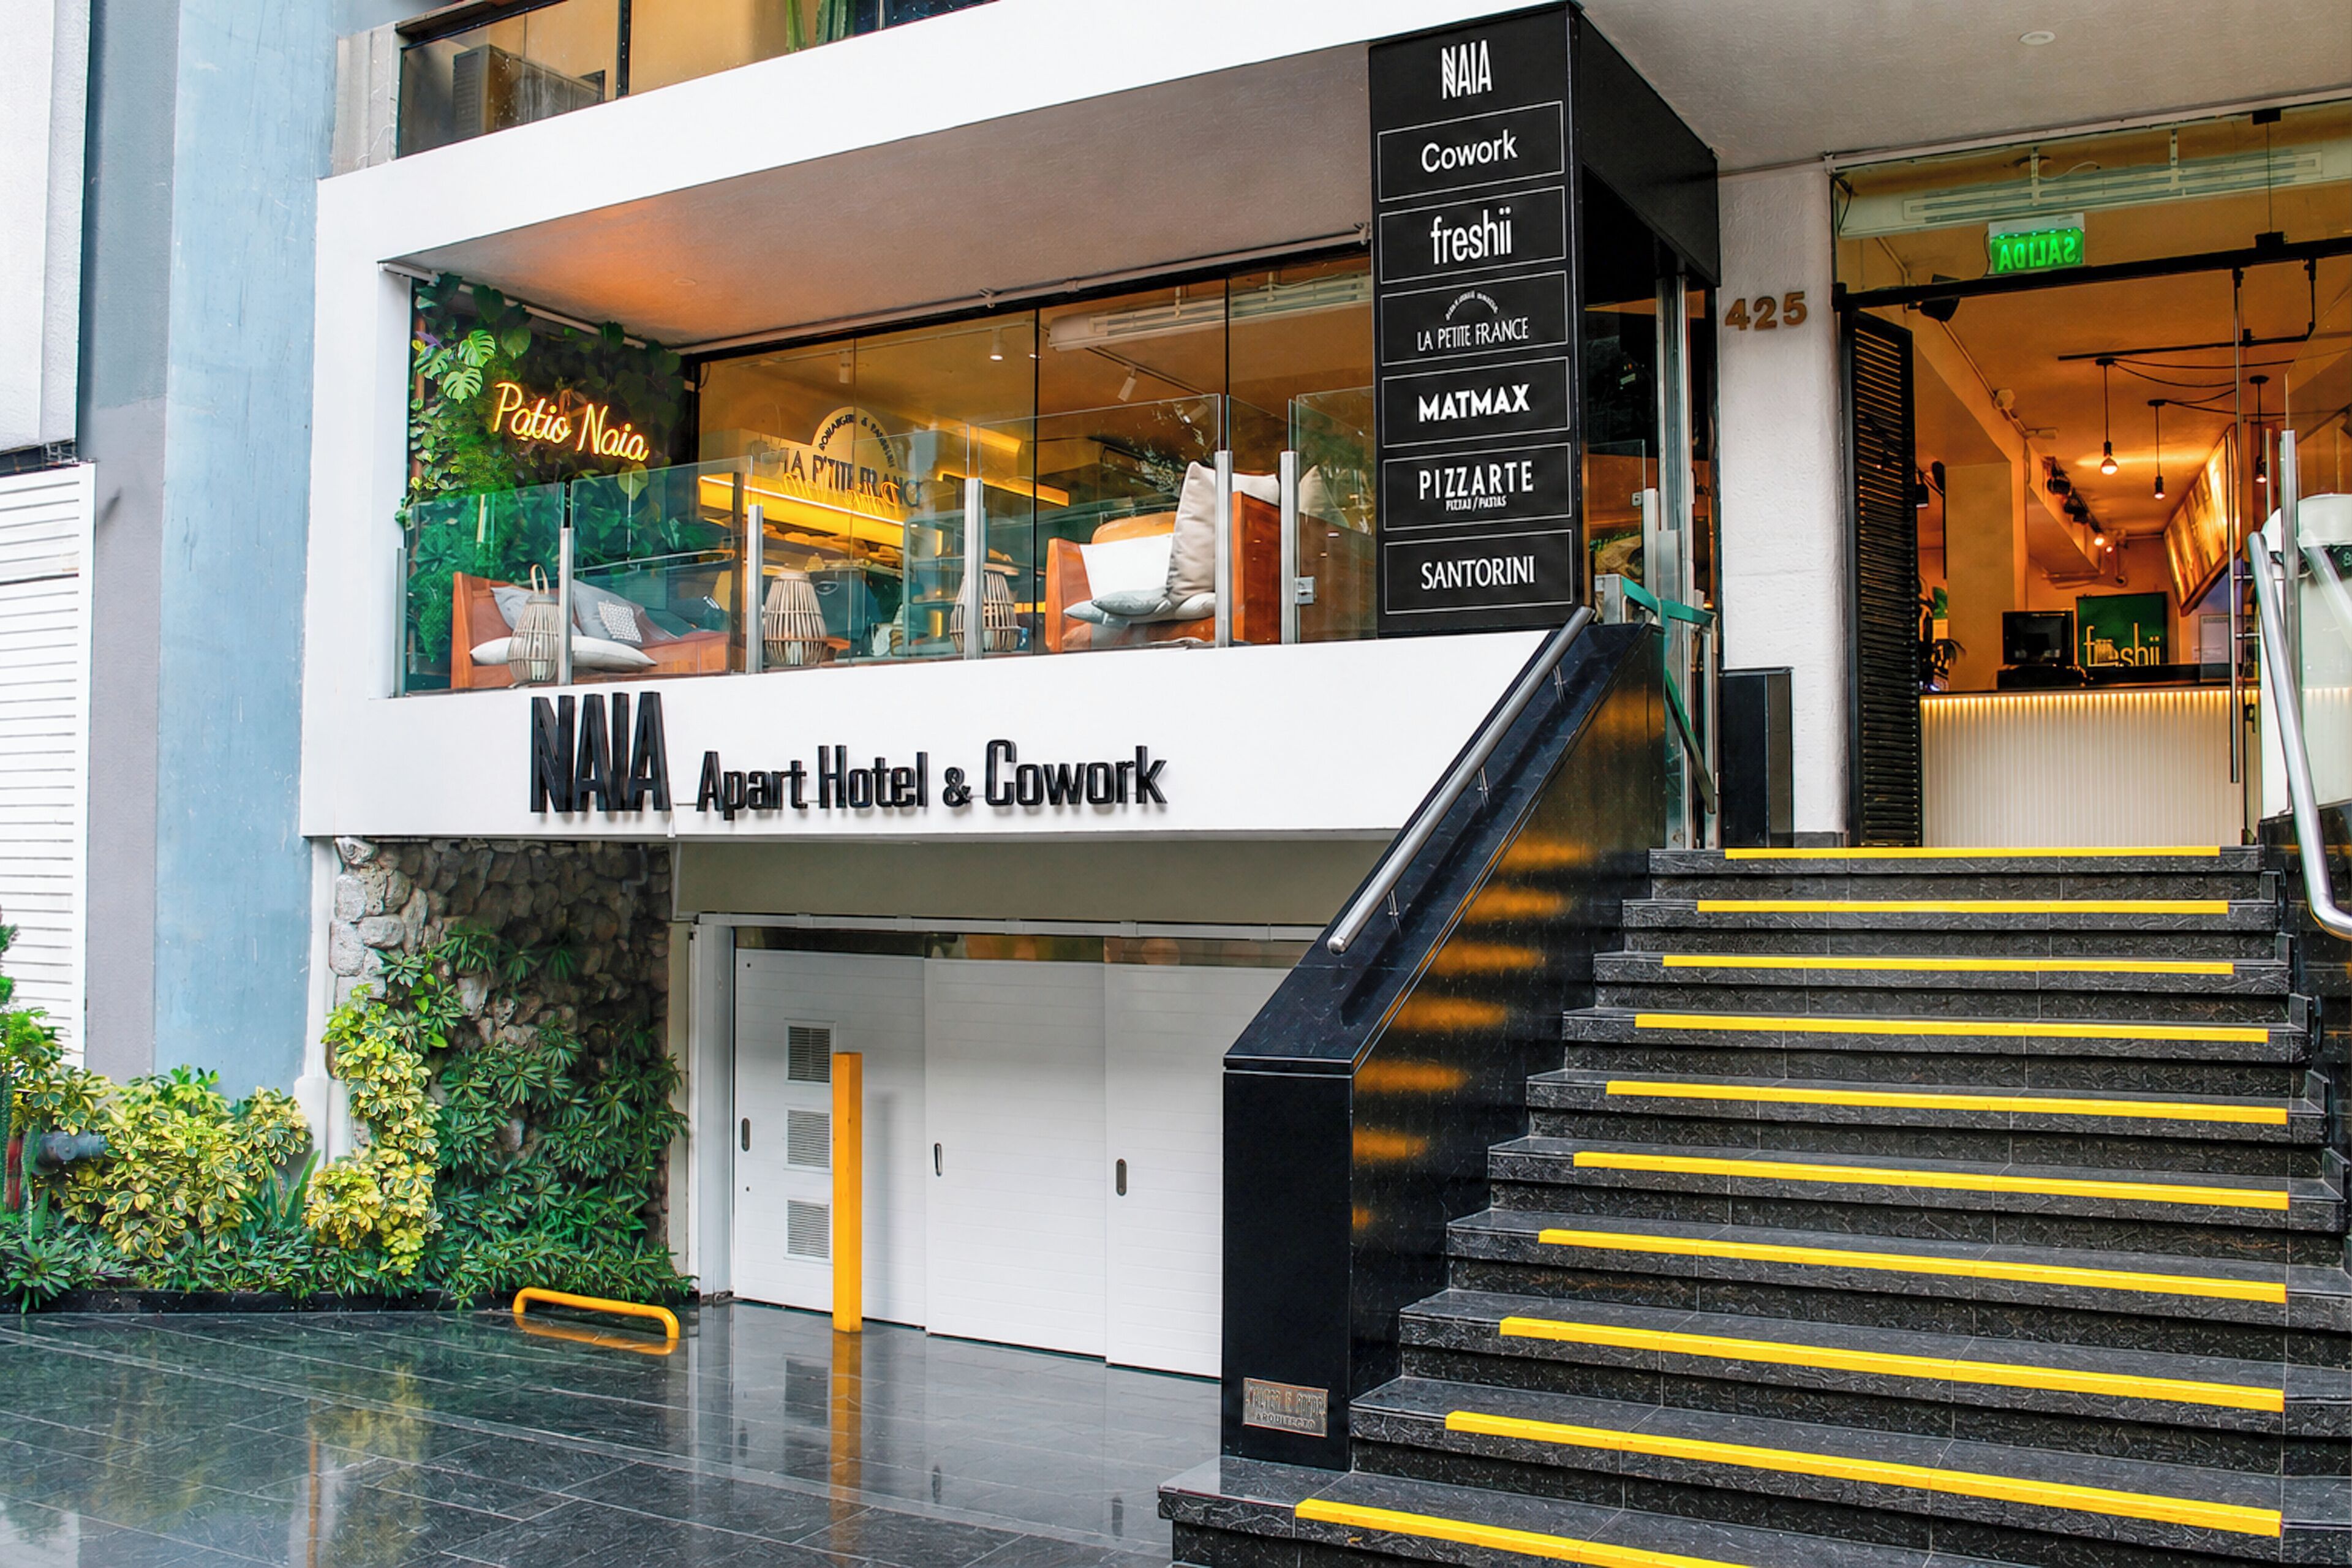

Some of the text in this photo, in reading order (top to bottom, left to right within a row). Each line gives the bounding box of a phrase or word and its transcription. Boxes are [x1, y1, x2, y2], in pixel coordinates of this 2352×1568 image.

[1441, 40, 1492, 99] NAIA
[1421, 129, 1518, 173] Cowork
[1430, 206, 1512, 265] freshii
[1725, 291, 1807, 331] 425
[1417, 317, 1529, 352] LA PETITE FRANCE
[492, 382, 650, 461] Patio Naia
[1419, 383, 1530, 422] MATMAX
[1419, 461, 1534, 500] PIZZARTE
[1421, 556, 1535, 590] SANTORINI
[529, 691, 1167, 821] NAIA Apart Hotel & Cowork
